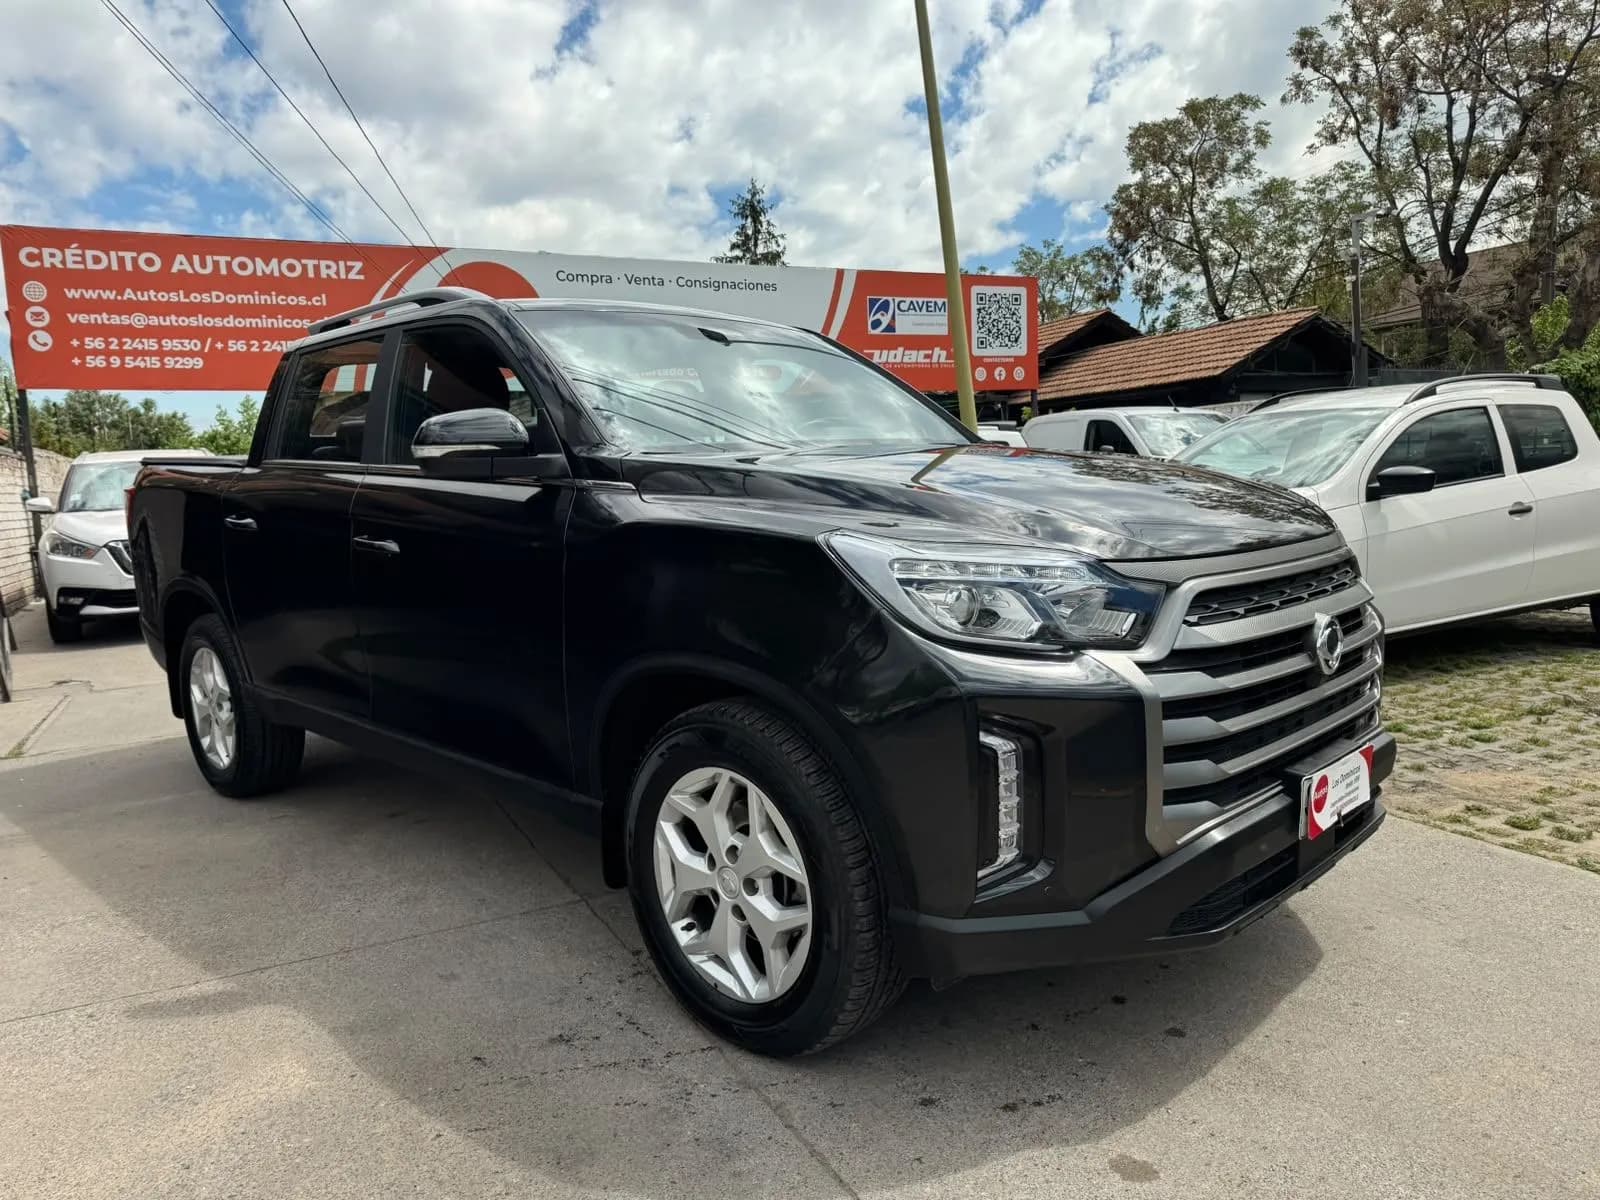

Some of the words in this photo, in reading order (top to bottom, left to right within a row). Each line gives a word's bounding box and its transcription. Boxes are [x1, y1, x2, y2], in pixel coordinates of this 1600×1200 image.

[18, 243, 162, 274] CRÉDITO
[170, 253, 365, 280] AUTOMOTRIZ
[555, 270, 613, 287] Compra
[624, 273, 665, 287] Venta
[676, 276, 778, 292] Consignaciones
[64, 287, 328, 307] www.AutosLosDominicos.cl
[896, 300, 946, 313] CAVEM
[66, 312, 329, 329] ventas@autoslosdominicos
[70, 338, 80, 348] +
[83, 337, 106, 350] 56
[108, 337, 120, 350] 2
[122, 338, 159, 351] 2415
[161, 338, 202, 352] 9530
[227, 340, 247, 352] 56
[250, 340, 260, 352] 2
[71, 357, 82, 367] +
[85, 355, 106, 368] 56
[109, 356, 121, 368] 9
[124, 356, 161, 369] 5415
[164, 357, 204, 369] 9299
